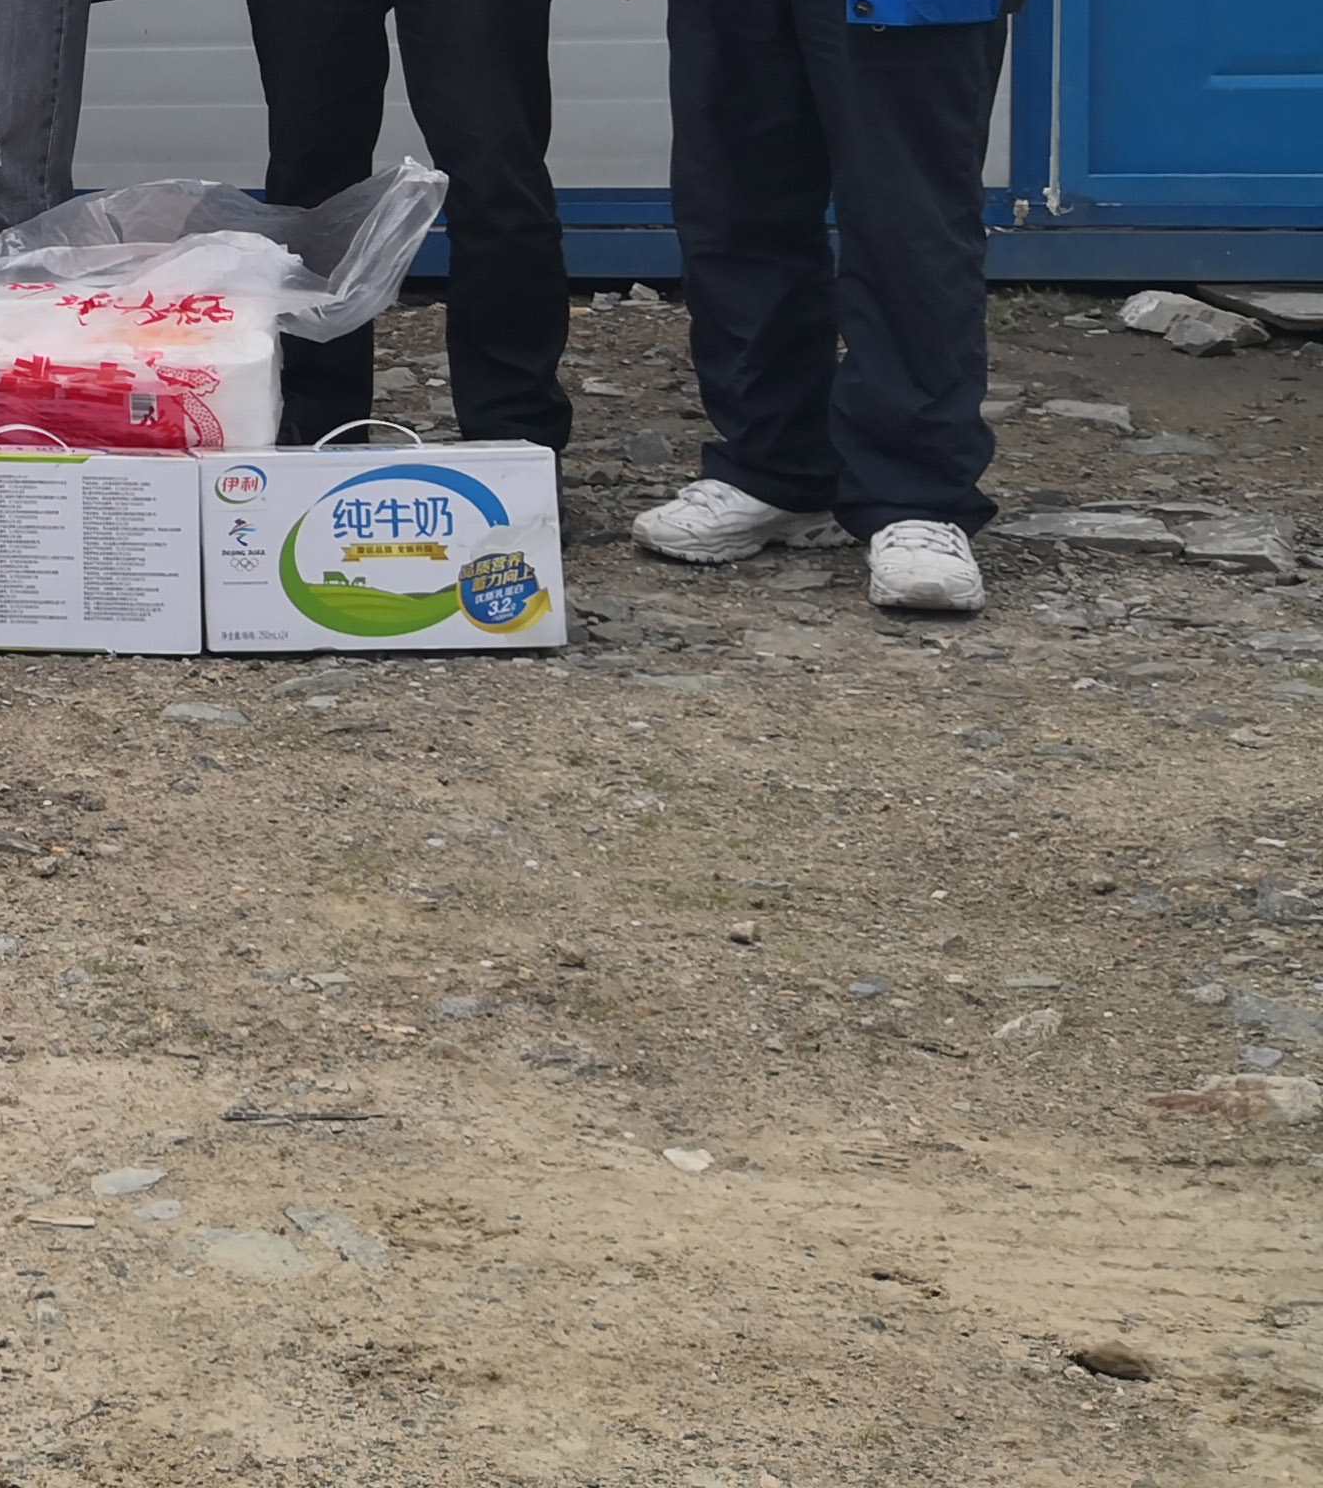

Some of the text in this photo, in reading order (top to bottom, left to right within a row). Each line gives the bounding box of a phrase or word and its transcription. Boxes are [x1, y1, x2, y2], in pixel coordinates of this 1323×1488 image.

[221, 476, 259, 494] 伊利
[331, 497, 454, 539] 纯牛奶
